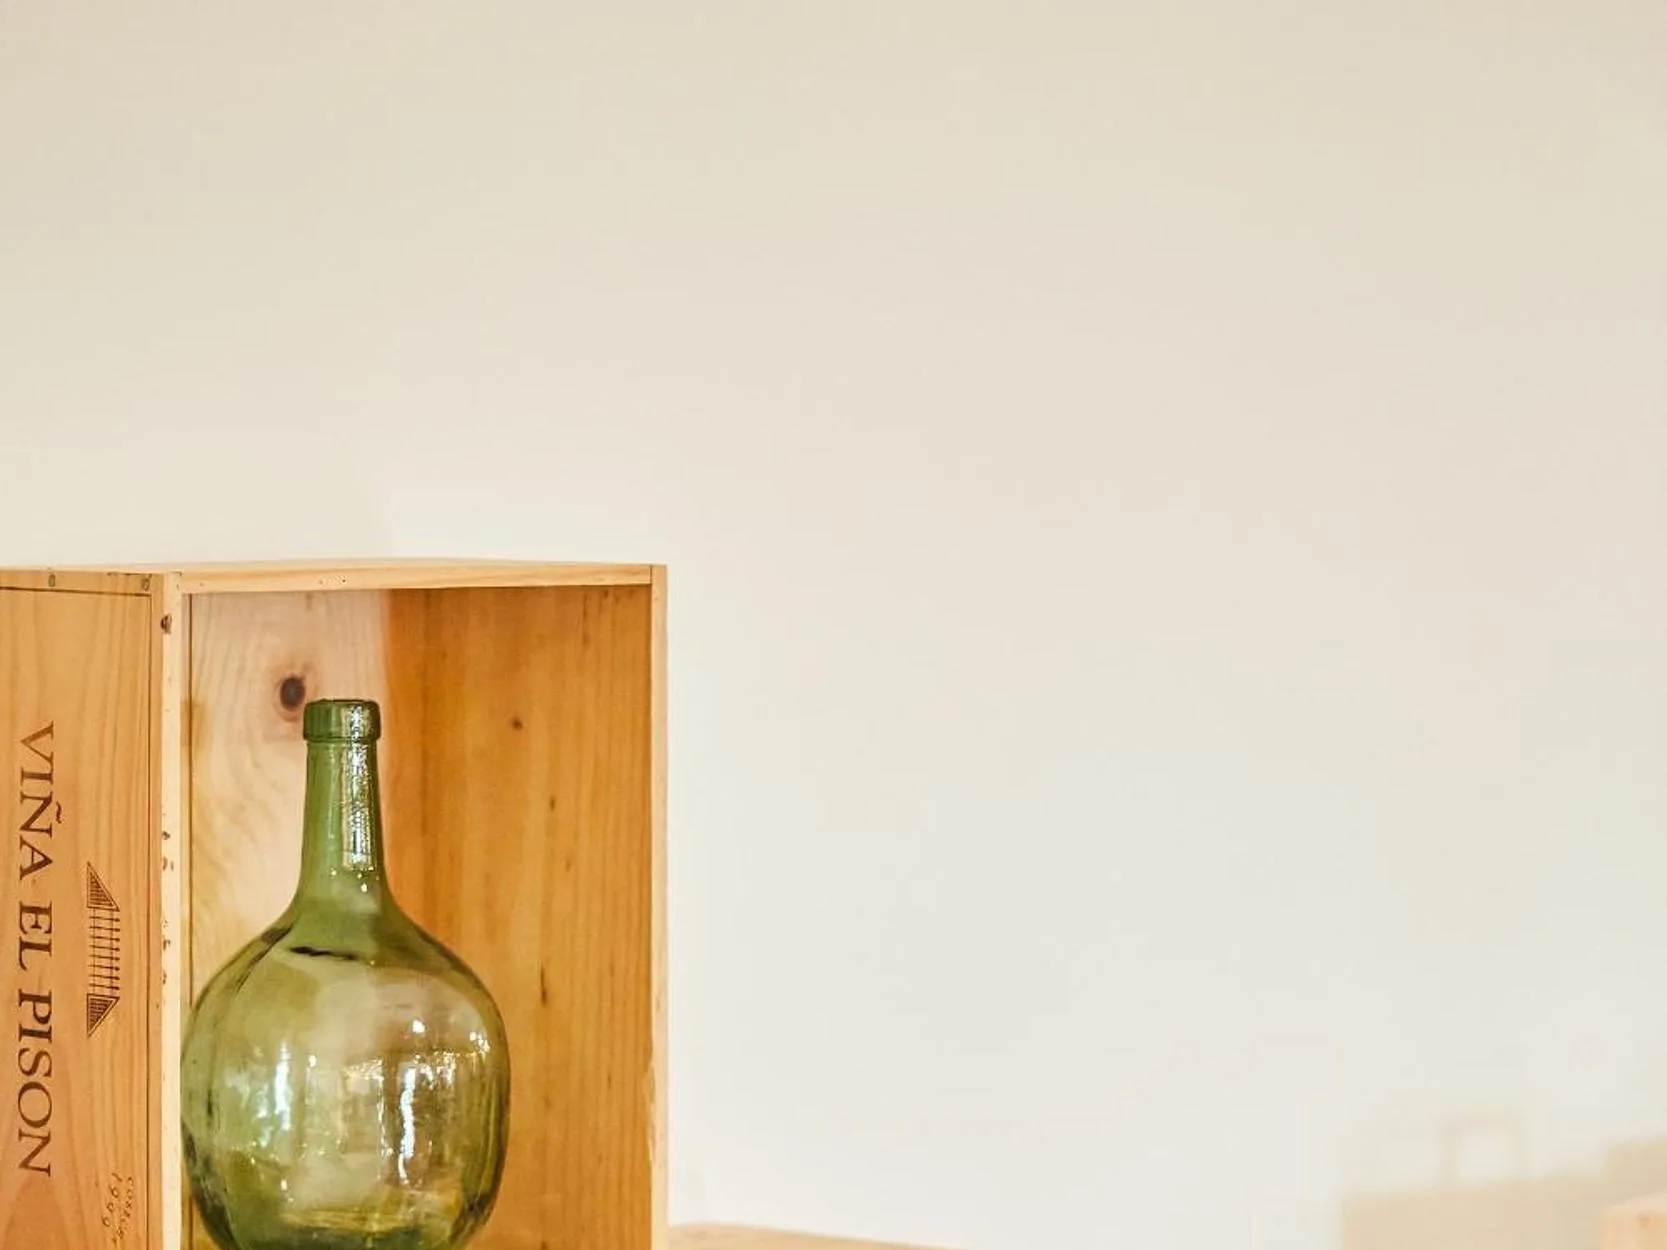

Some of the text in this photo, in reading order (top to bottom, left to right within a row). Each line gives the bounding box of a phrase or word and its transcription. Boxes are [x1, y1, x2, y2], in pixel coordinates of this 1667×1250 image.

[17, 720, 62, 1178] VIÑA EL PISON
